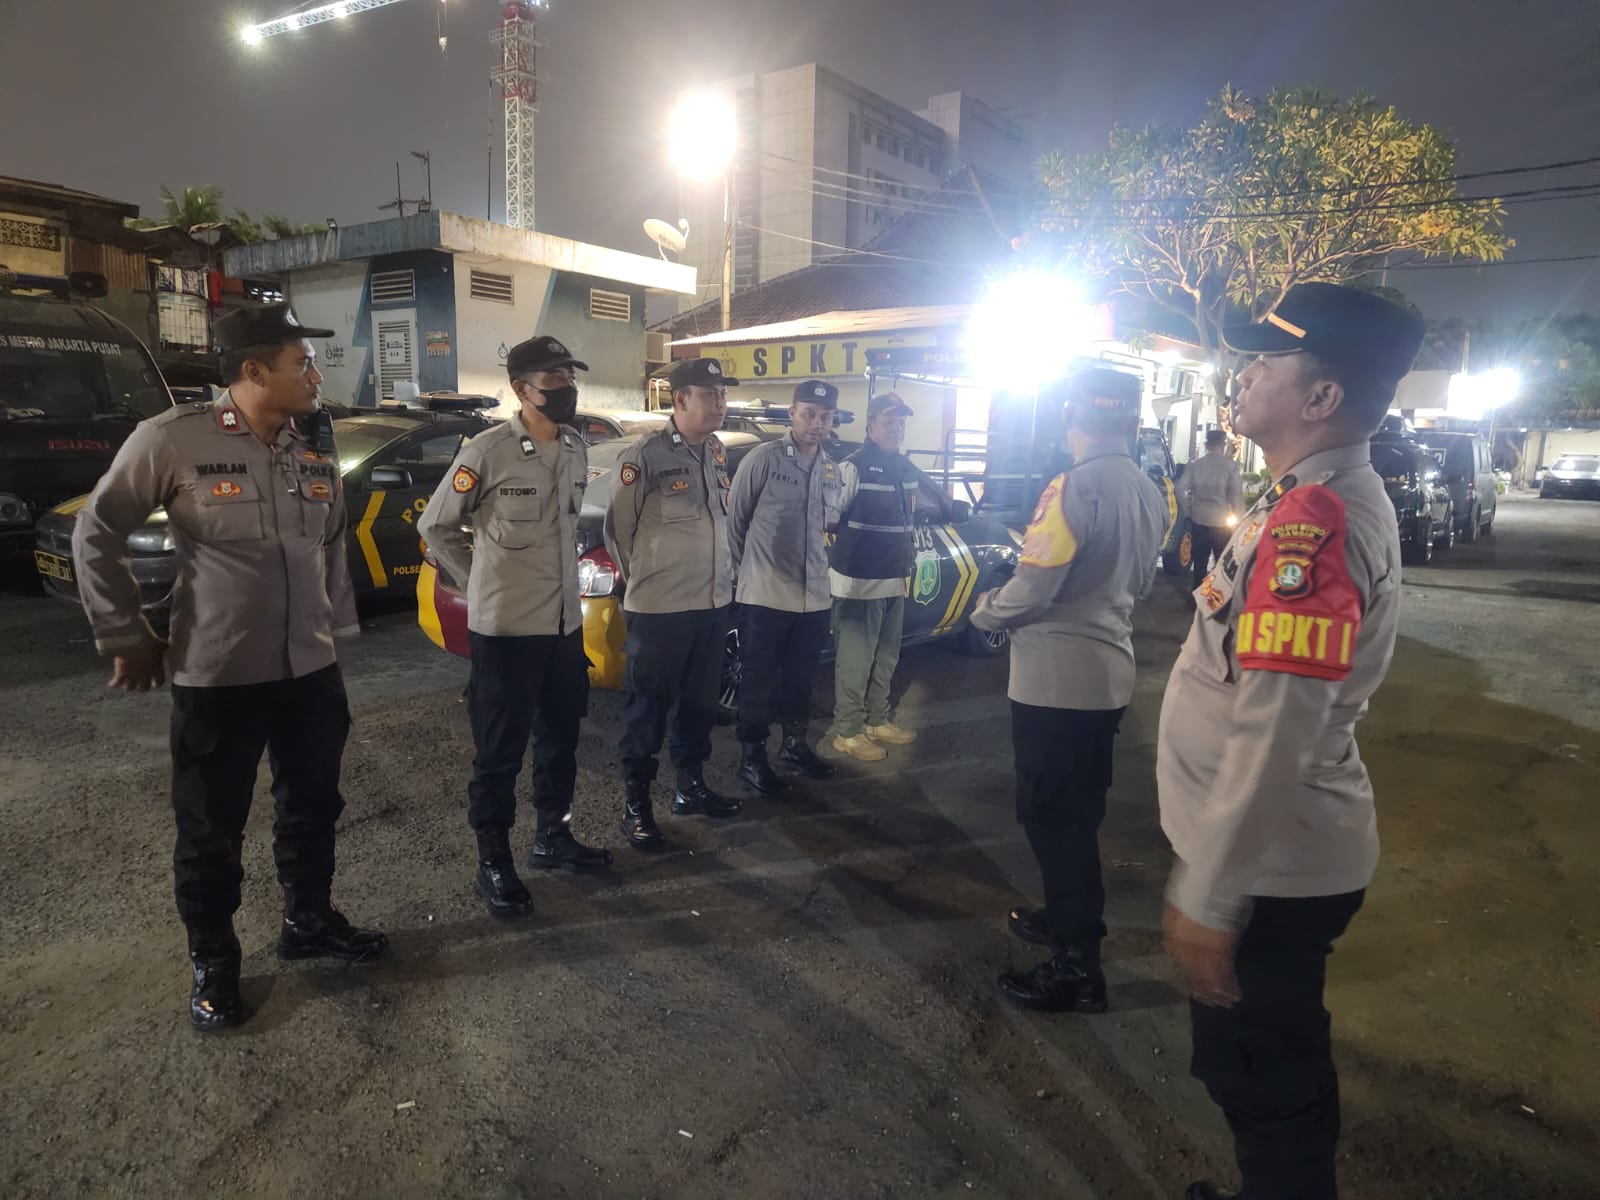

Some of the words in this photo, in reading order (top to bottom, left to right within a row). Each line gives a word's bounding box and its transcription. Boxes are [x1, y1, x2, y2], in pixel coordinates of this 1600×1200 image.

[8, 335, 46, 349] METRO
[47, 338, 92, 353] JAKARTA
[91, 341, 122, 356] PUSAT
[752, 342, 858, 377] SPKT
[500, 487, 537, 496] ISTOMO
[393, 565, 421, 576] POLSE
[1255, 611, 1333, 660] SPKT
